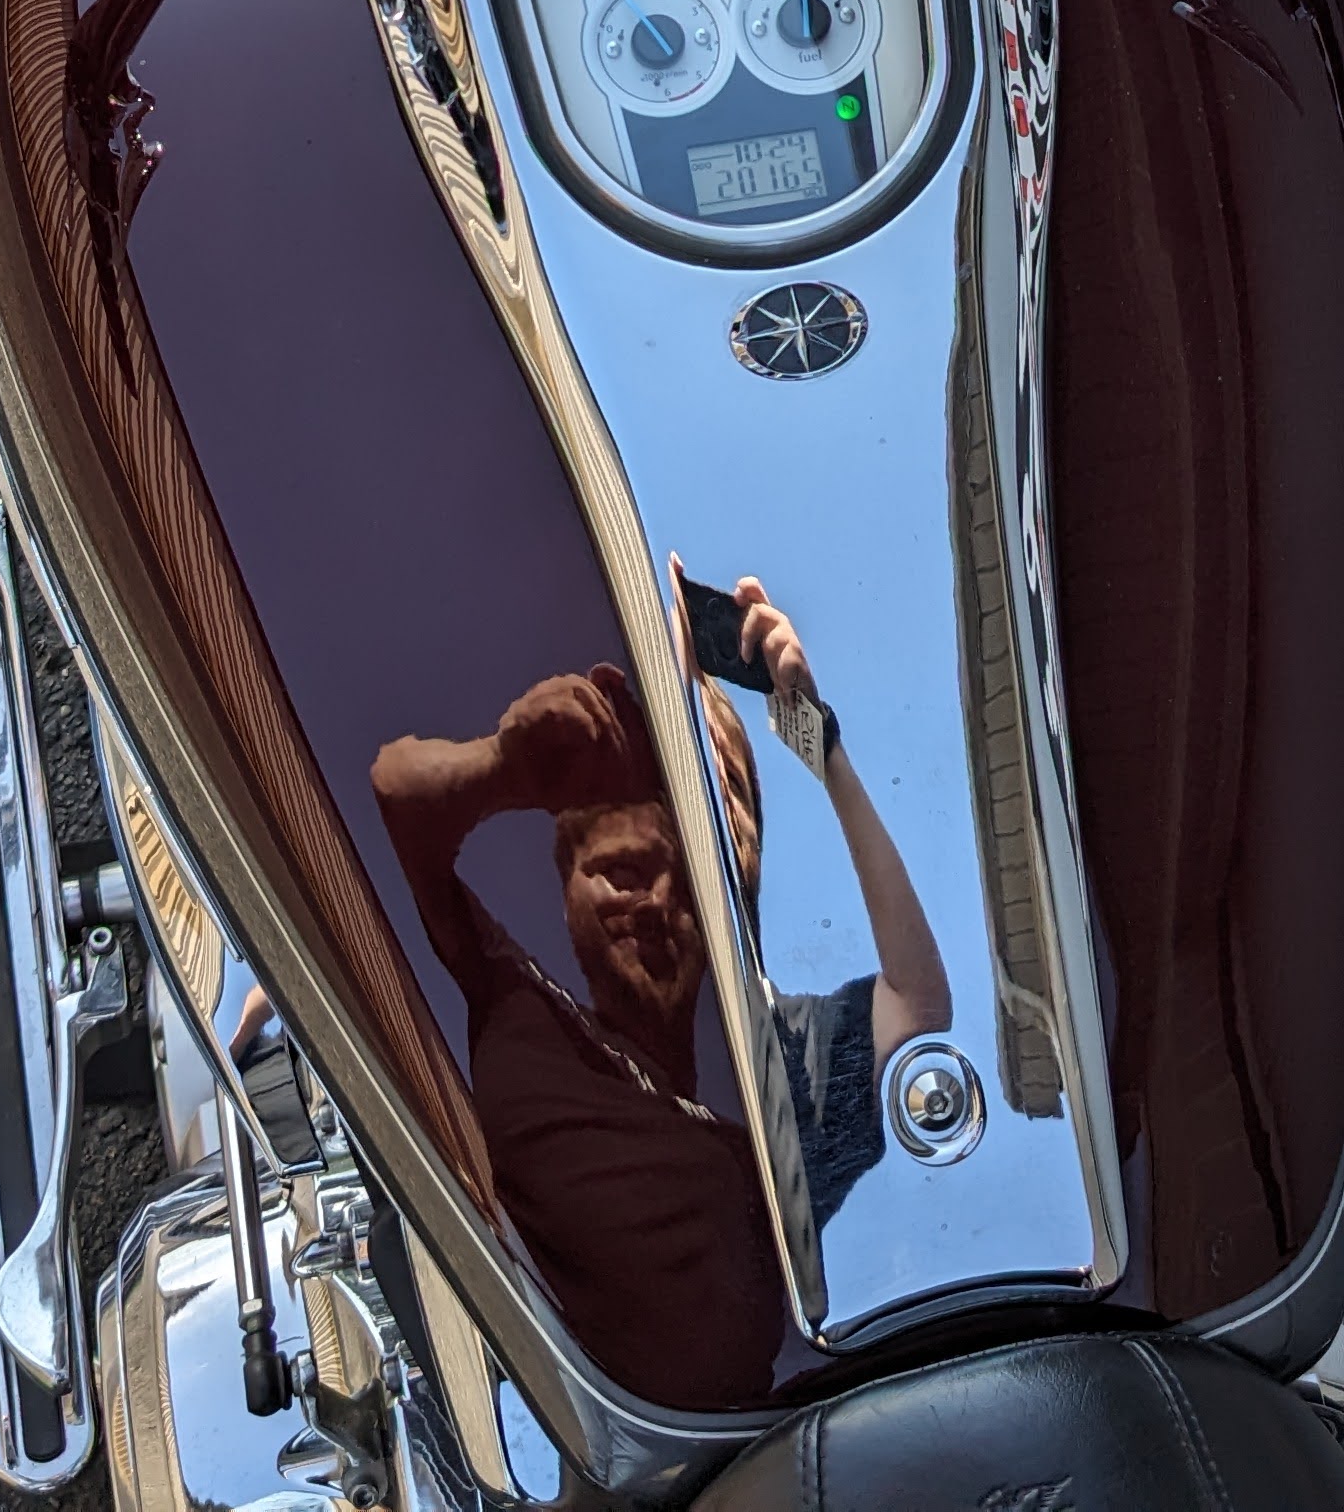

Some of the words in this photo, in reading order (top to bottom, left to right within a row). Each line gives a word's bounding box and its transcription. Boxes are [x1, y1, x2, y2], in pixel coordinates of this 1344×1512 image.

[692, 7, 699, 16] 3
[606, 25, 613, 33] 0
[706, 43, 713, 52] 4
[798, 48, 823, 64] fuel
[696, 70, 703, 79] 5
[664, 88, 672, 97] 6
[842, 101, 855, 113] N
[716, 157, 822, 199] 20165
